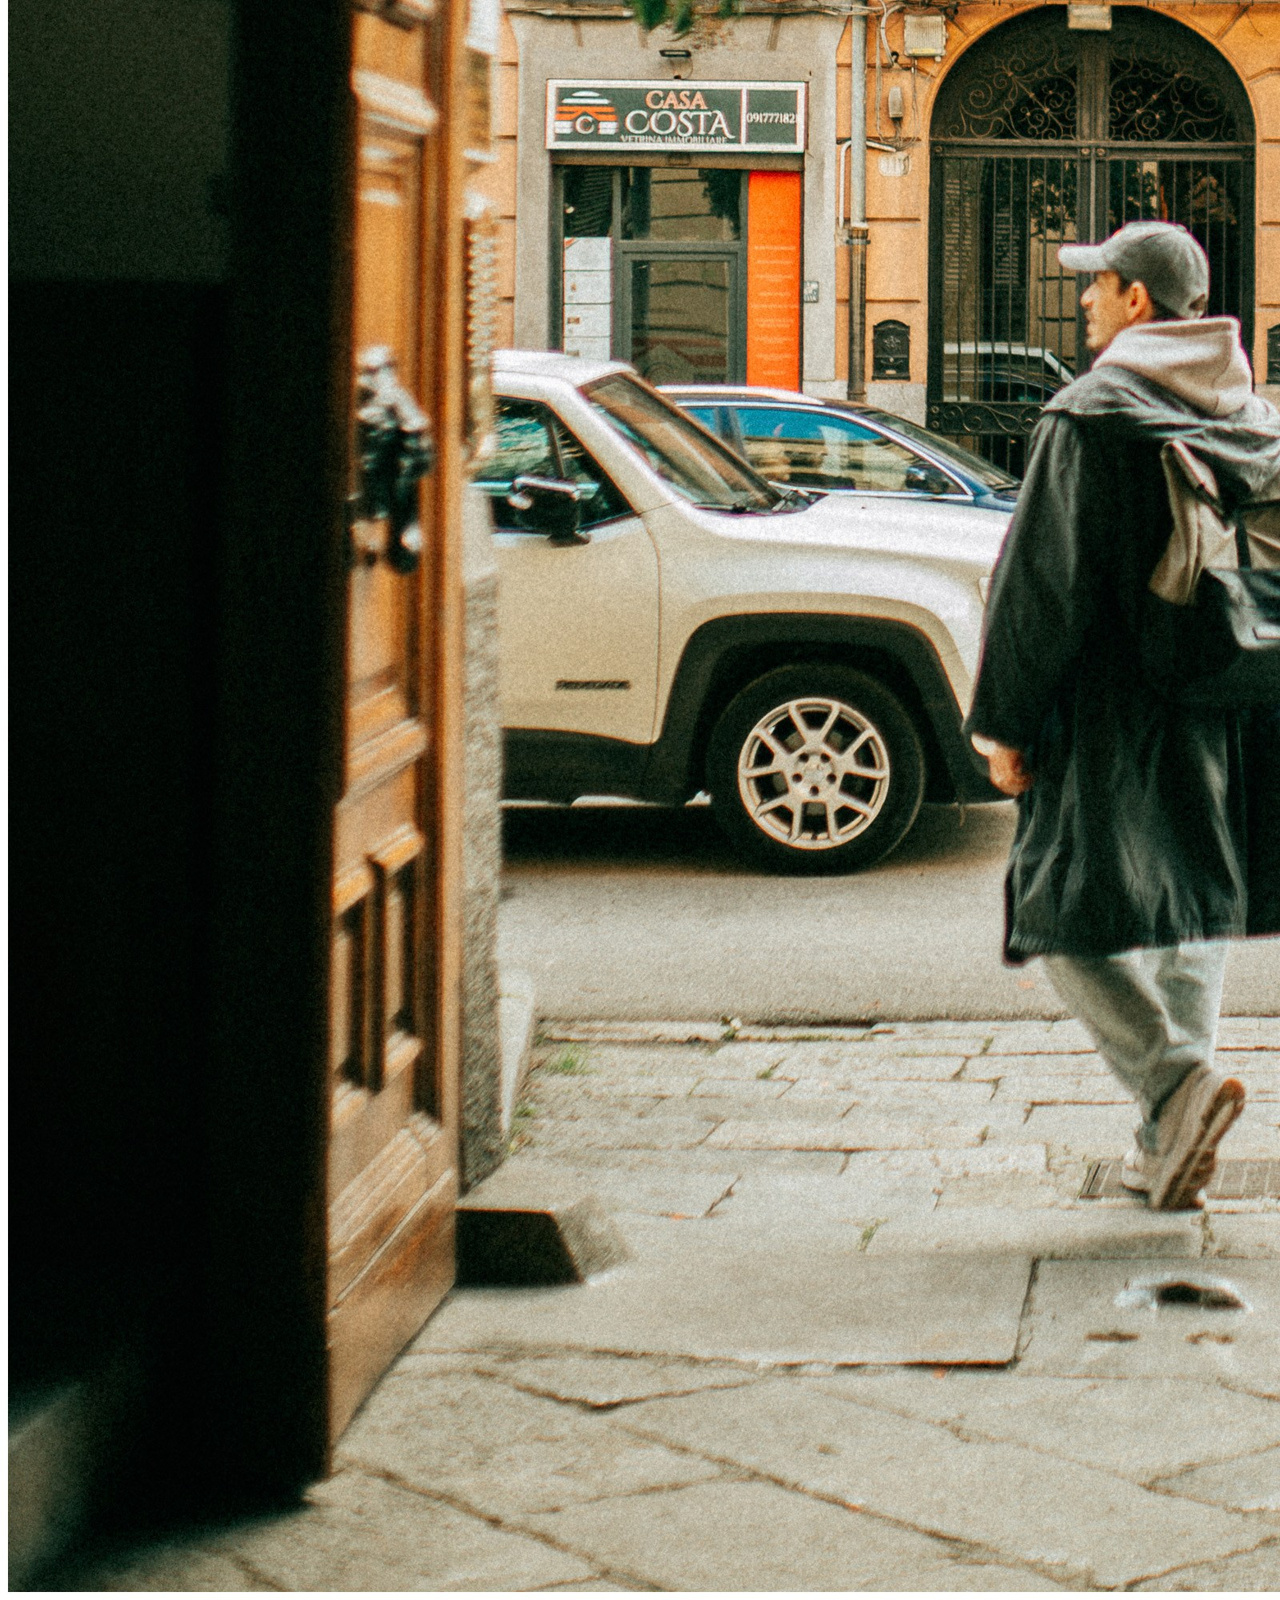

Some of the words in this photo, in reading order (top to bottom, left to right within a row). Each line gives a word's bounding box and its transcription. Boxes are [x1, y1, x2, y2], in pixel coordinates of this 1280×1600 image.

[645, 90, 708, 109] CASA
[625, 109, 735, 139] COSTA
[620, 135, 662, 143] VETRINA
[664, 135, 728, 144] IMMOBILIARE
